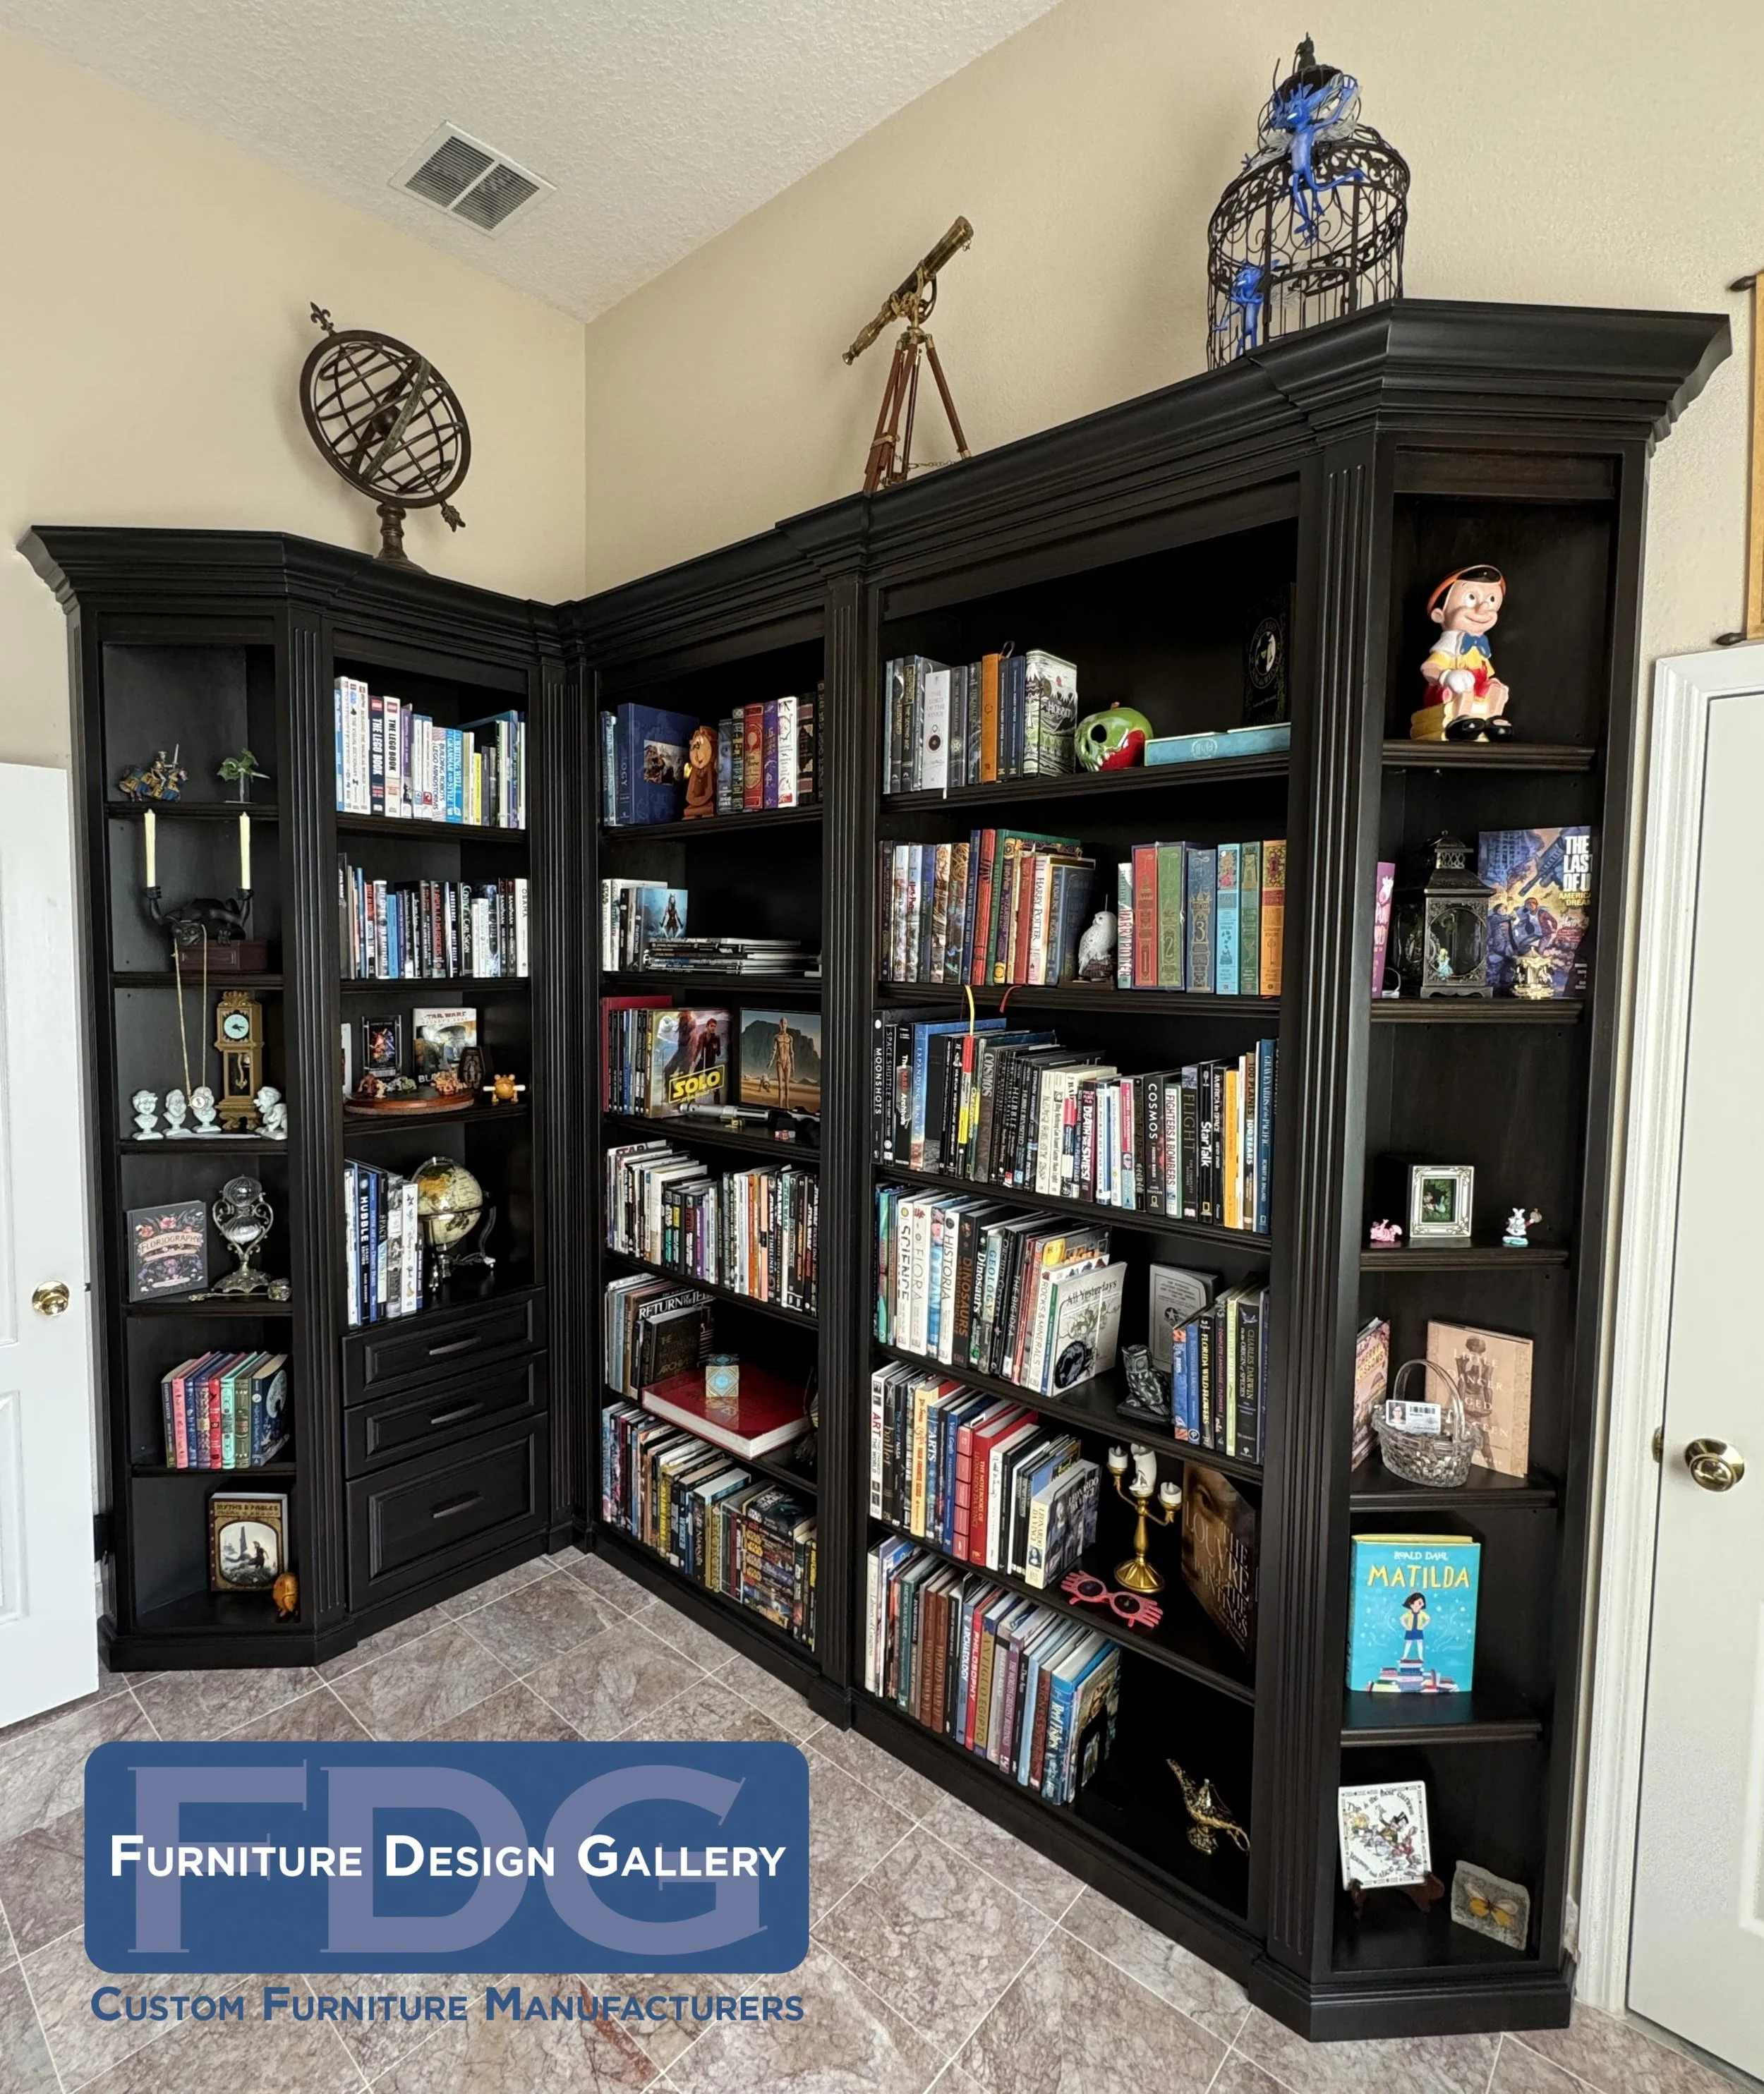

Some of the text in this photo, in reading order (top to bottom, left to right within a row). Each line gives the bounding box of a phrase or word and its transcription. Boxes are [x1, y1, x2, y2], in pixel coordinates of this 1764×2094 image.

[372, 718, 382, 775] THE LEGO BOOK
[1565, 835, 1590, 854] THE
[1563, 873, 1578, 892] OF
[1034, 878, 1044, 941] HARRY POTTER
[1118, 909, 1132, 976] HARRY POTTER
[673, 1070, 720, 1099] SOLO
[981, 1053, 995, 1097] COSMOS
[1010, 1087, 1019, 1128] HUBBLE
[1082, 1106, 1092, 1134] DEATH
[1149, 1083, 1158, 1139] COSMOS
[1166, 1094, 1174, 1137] FIGHTERS
[1184, 1094, 1195, 1153] FLIGHT
[1166, 1144, 1175, 1185] BOMBERS
[1201, 1121, 1212, 1167] StarTalk
[898, 1225, 911, 1301] SCIENCE
[912, 1248, 924, 1301] FLORA
[942, 1235, 954, 1300] HISTORIA
[974, 1252, 986, 1314] Dinosaurs
[986, 1250, 996, 1314] GEOLOGY
[639, 1297, 683, 1321] RETURN
[959, 1257, 972, 1337] DINOSAURS
[1039, 1281, 1049, 1311] ROCKS
[1081, 1279, 1118, 1303] Yesterdays
[1032, 1320, 1044, 1365] MINERALS
[1246, 1330, 1255, 1364] CHARLES
[1454, 1348, 1499, 1368] LITTLE
[872, 1412, 881, 1436] ART
[882, 1425, 893, 1466] ballet
[928, 1431, 936, 1462] ARTS
[1185, 1501, 1250, 1604] LOUVRE
[1394, 1551, 1449, 1560] ROALD DAHL
[1367, 1565, 1470, 1589] MATILDA
[961, 1625, 972, 1682] ARCHAEOLOGY
[969, 1630, 979, 1701] PHILOSOPHY
[976, 1635, 991, 1743] ANTIGUO EGIPTO
[1049, 1702, 1064, 1750] Reef Fishes
